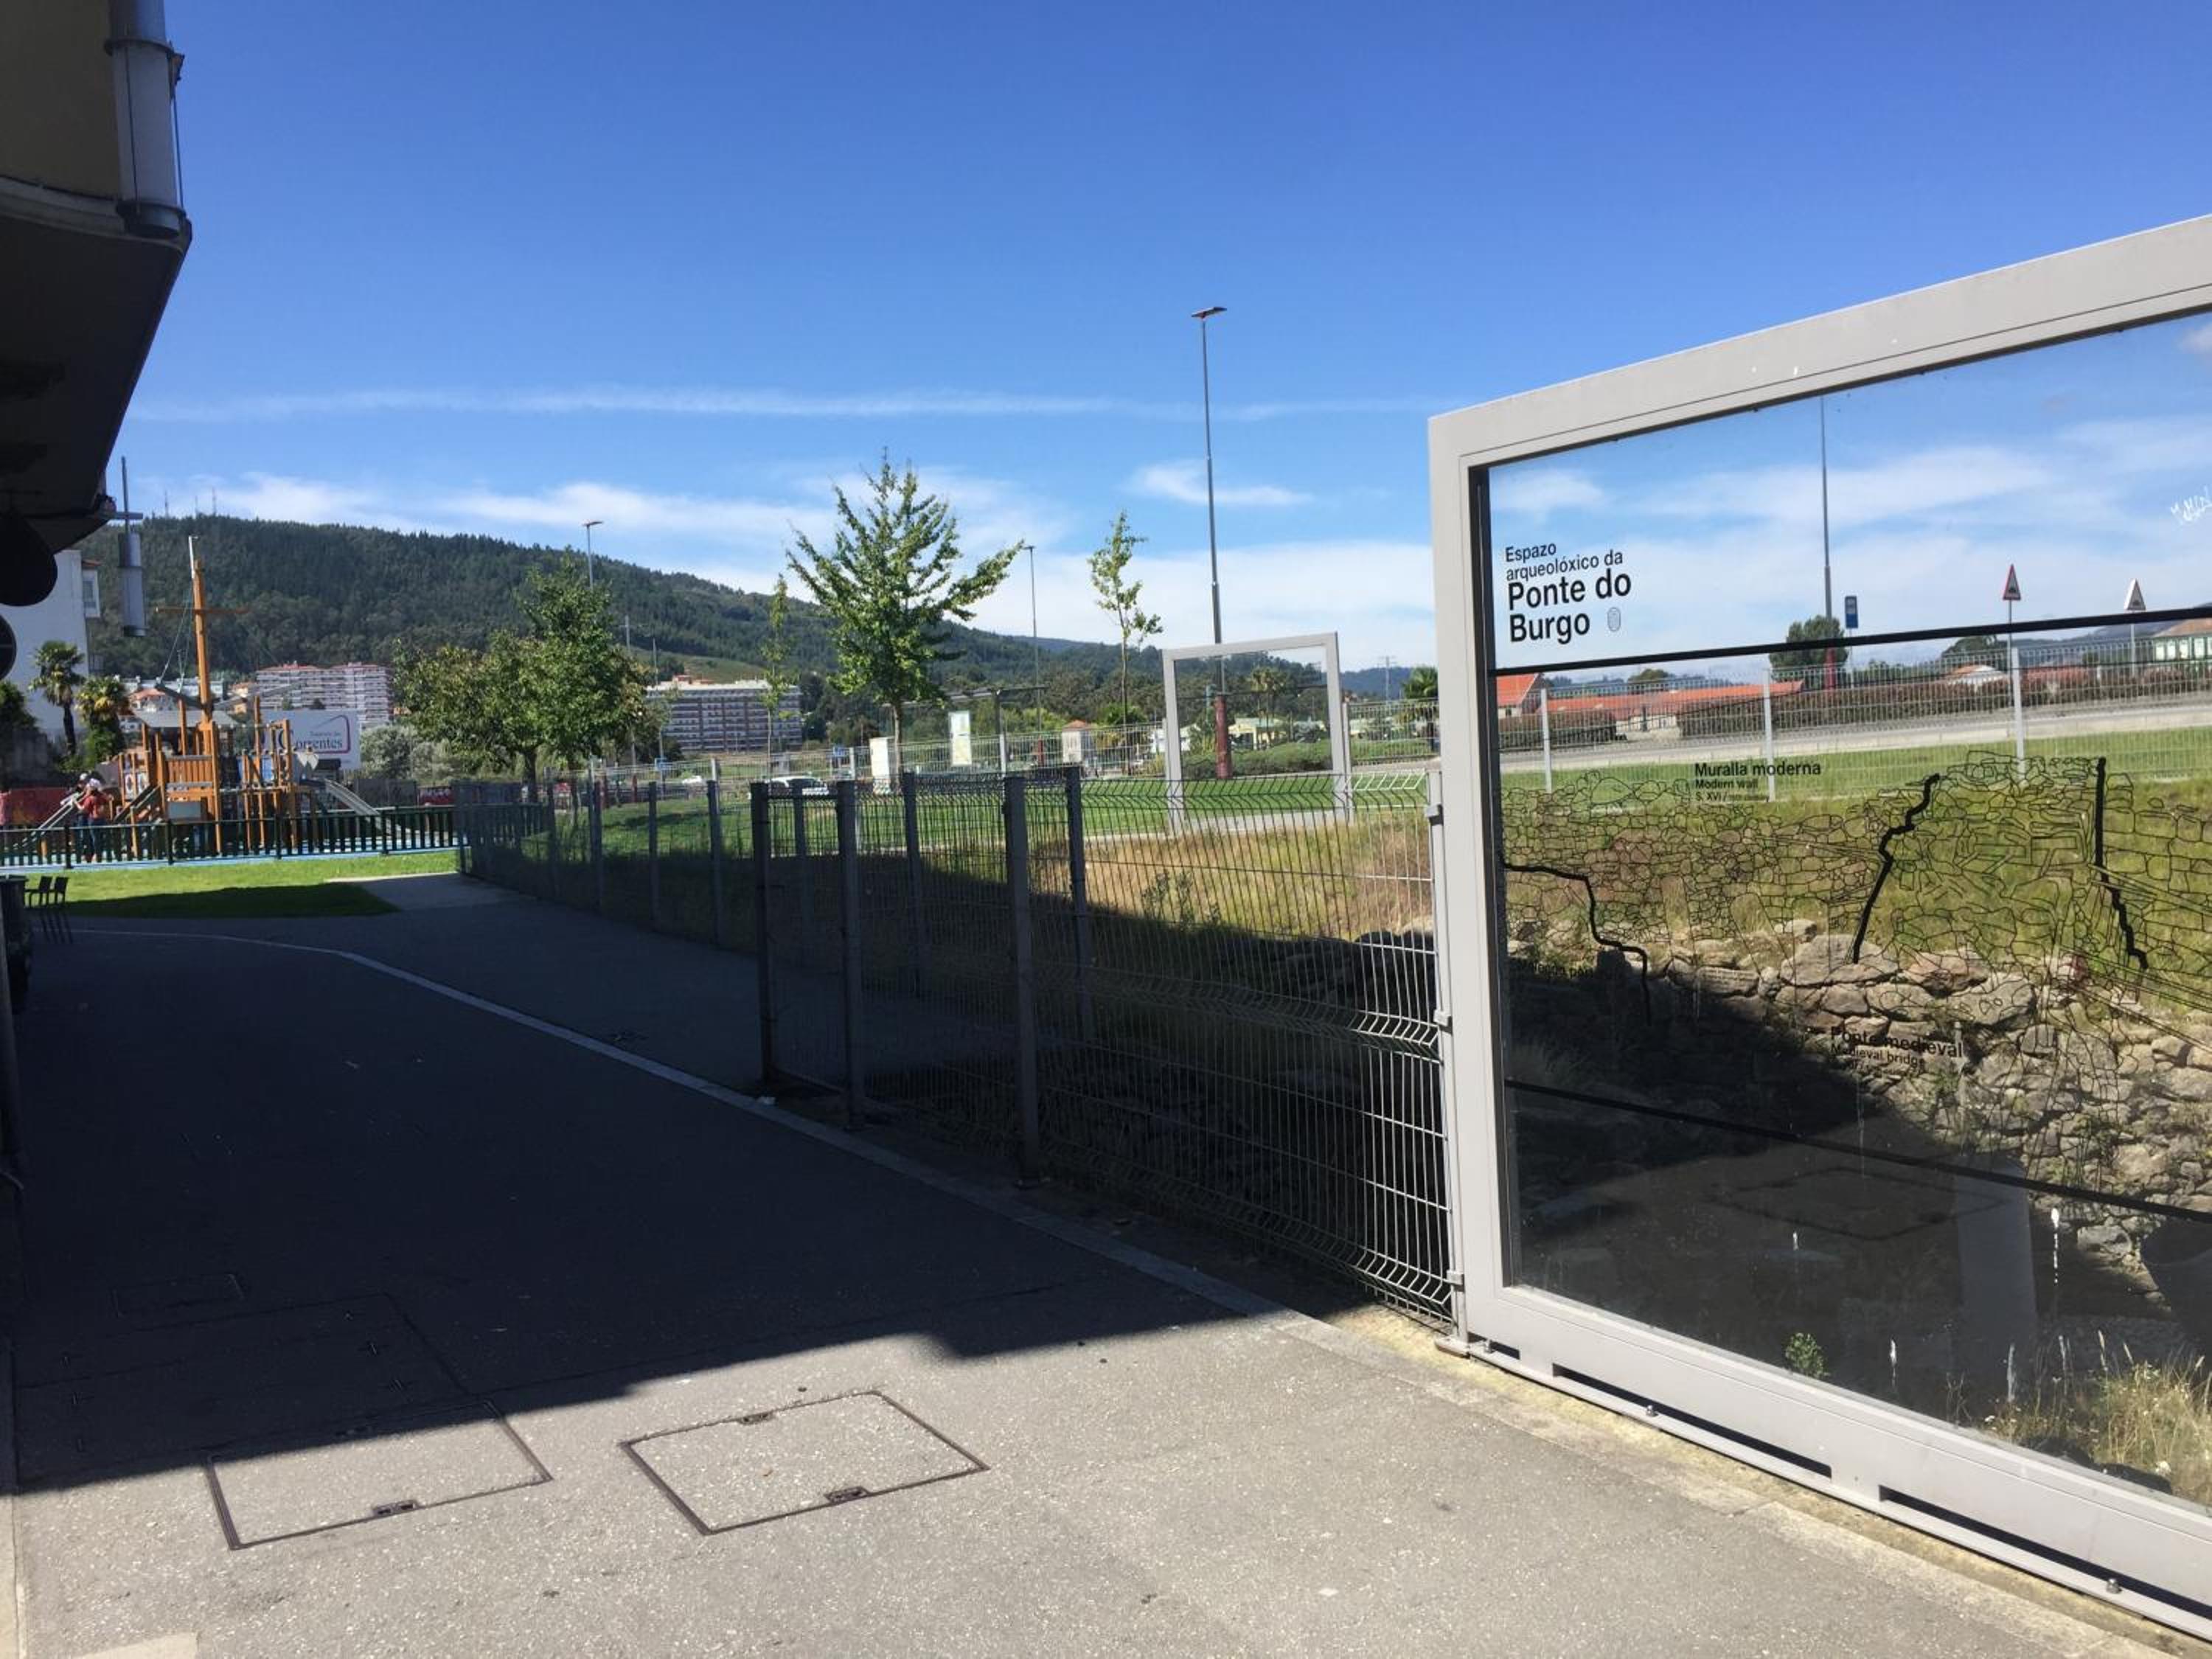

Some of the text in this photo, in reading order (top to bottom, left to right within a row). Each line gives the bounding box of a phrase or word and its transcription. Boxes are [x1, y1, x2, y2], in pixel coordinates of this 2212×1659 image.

[1505, 543, 1557, 563] Espazo
[1506, 549, 1624, 582] arqueolóxico da
[1508, 568, 1632, 611] Ponte do
[1509, 613, 1590, 644] Burgo
[1694, 761, 1821, 777] Muralla moderna
[1694, 779, 1735, 790] Modern
[1831, 1026, 1963, 1058] Ponte medieval
